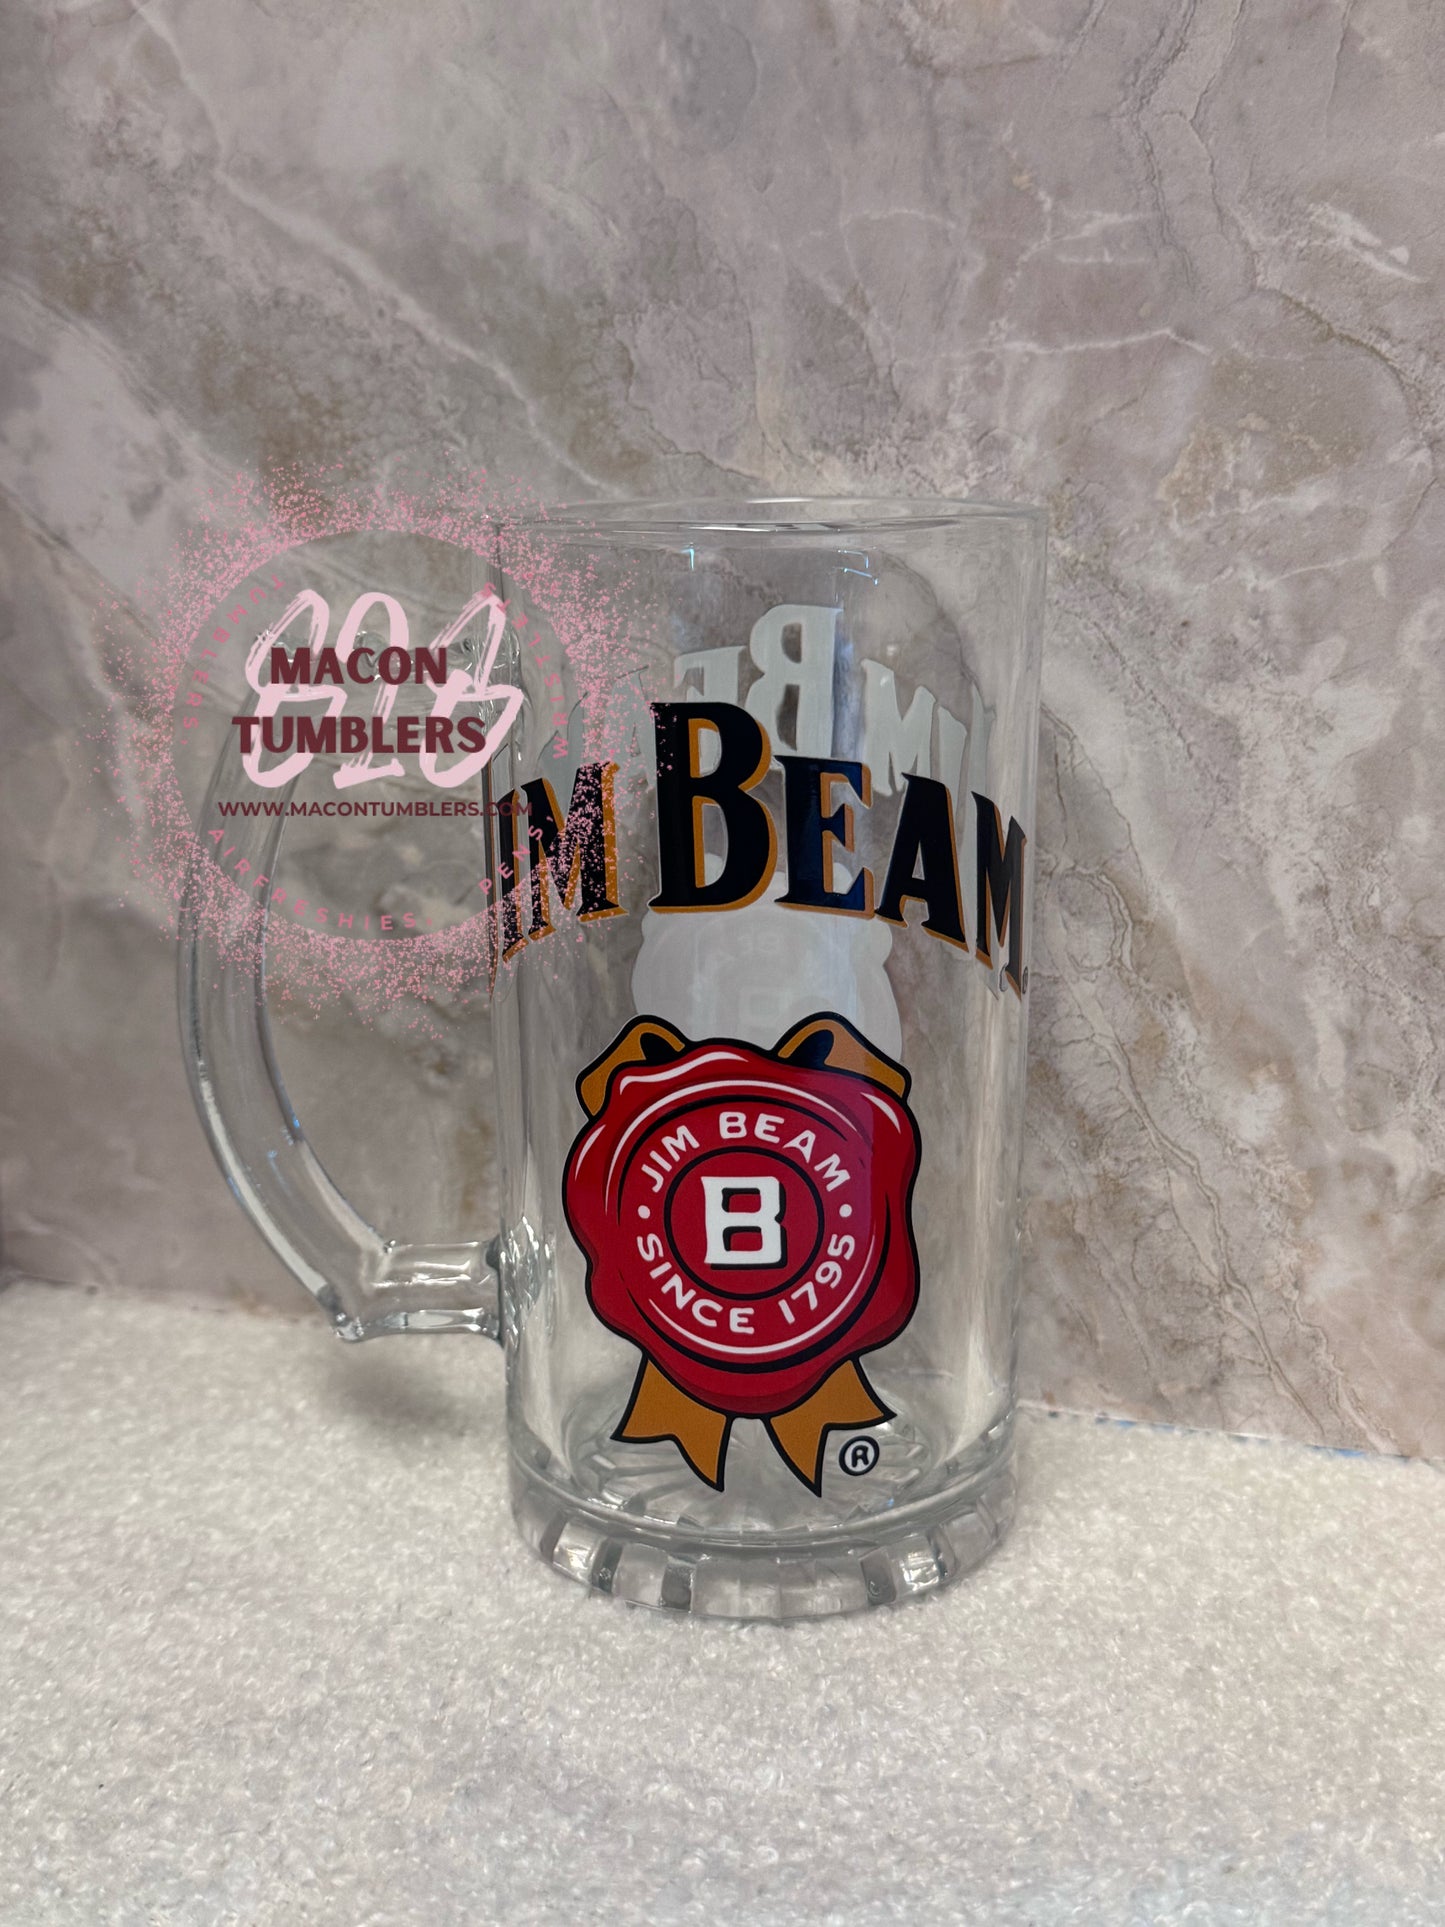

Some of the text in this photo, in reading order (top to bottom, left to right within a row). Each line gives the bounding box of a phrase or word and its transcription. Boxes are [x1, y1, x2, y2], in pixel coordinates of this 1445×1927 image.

[647, 701, 1028, 1002] BEAM
[639, 1110, 851, 1193] JIM BEAM
[700, 1175, 788, 1271] B
[636, 1232, 856, 1335] SINCE 1795
